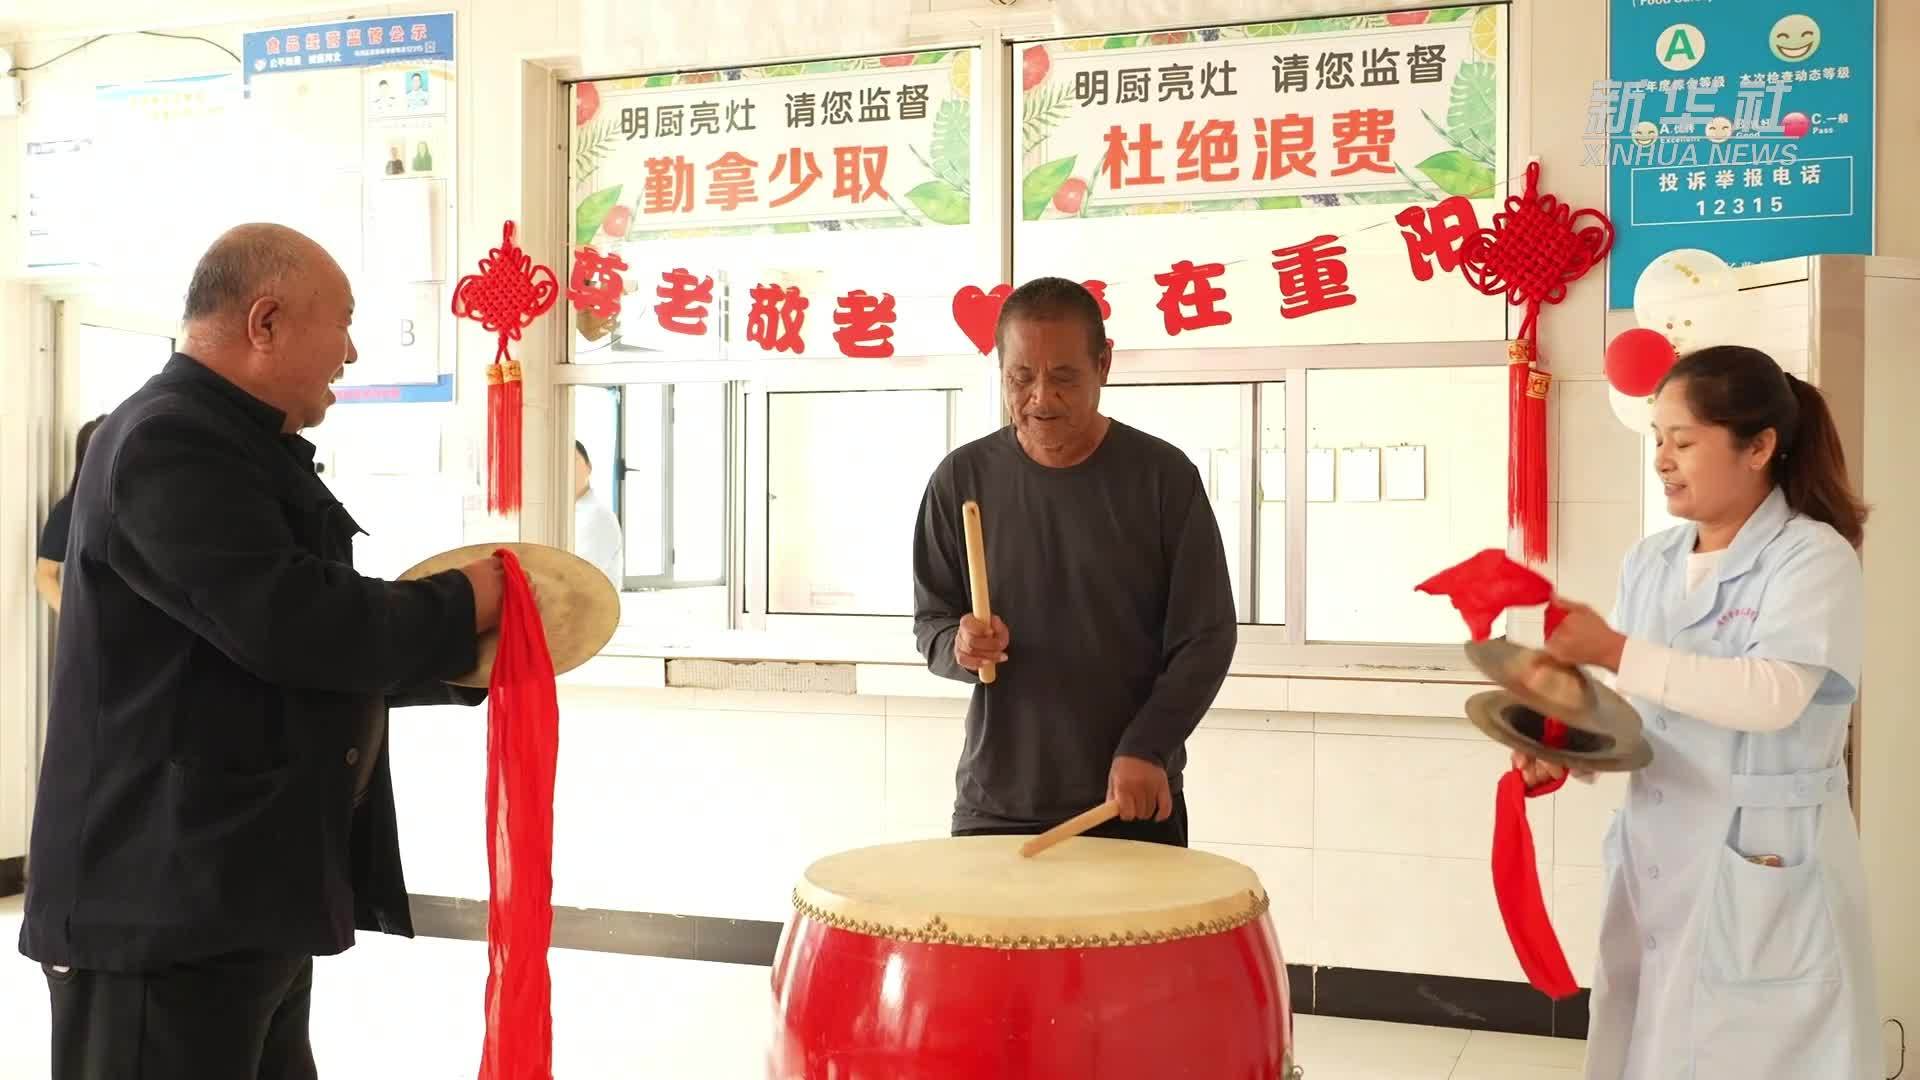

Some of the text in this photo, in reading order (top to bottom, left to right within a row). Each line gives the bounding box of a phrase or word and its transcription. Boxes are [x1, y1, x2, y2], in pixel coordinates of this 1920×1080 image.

[1664, 29, 1696, 62] A
[1075, 44, 1447, 108] 明厨亮灶 请您监督
[1739, 67, 1850, 85] 本次检查动态等级
[620, 84, 929, 141] 明厨亮灶 请您监督
[1812, 127, 1834, 135] Pass
[1102, 108, 1397, 190] 杜绝浪费
[643, 145, 890, 214] 勤拿少取
[1659, 164, 1821, 192] 投诉举报电话
[1696, 196, 1783, 216] 12315
[567, 247, 897, 359] 尊老敬老
[400, 318, 416, 347] B
